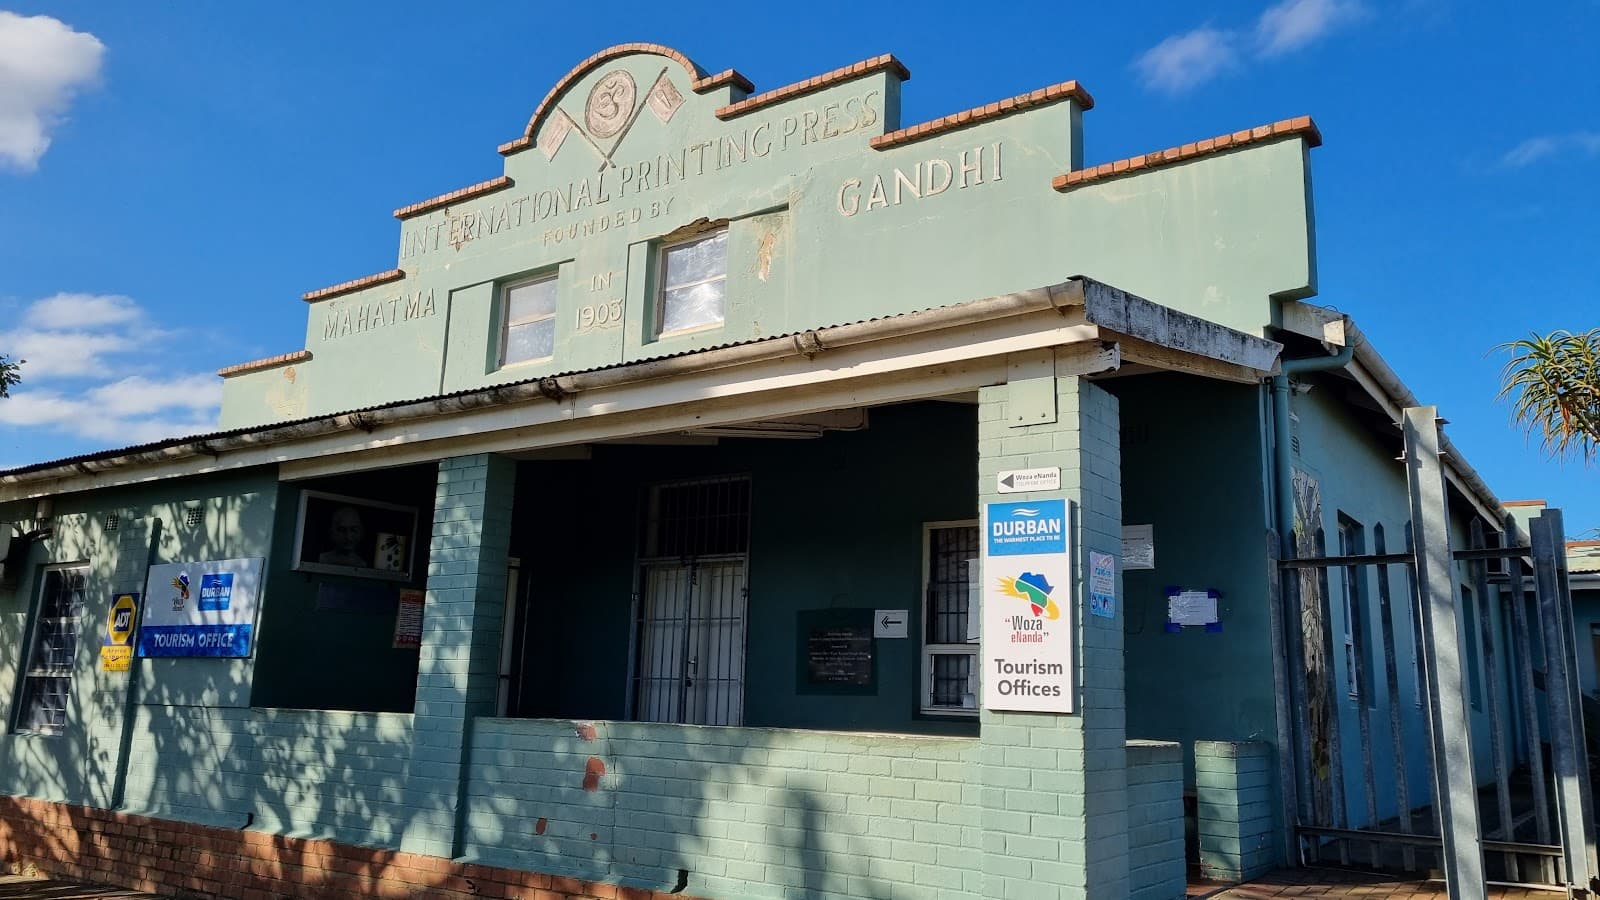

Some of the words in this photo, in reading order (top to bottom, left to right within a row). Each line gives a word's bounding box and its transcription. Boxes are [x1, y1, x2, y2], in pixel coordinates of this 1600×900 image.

[400, 171, 610, 260] INTERNATIONAL
[618, 122, 772, 198] PRINTING
[781, 90, 879, 152] PRESS
[543, 206, 642, 247] FOUNDED
[649, 197, 676, 219] BY
[322, 287, 436, 341] MAHATMA
[837, 142, 1003, 217] GANDHI
[591, 271, 612, 292] IN
[576, 298, 623, 330] 1903
[993, 518, 1060, 537] DURBAN
[201, 587, 231, 598] DURBAN
[114, 612, 131, 628] ADT
[154, 633, 196, 648] TOURISM
[199, 633, 235, 648] OFFICE
[993, 658, 1063, 675] Tourism
[997, 679, 1061, 697] Offices
